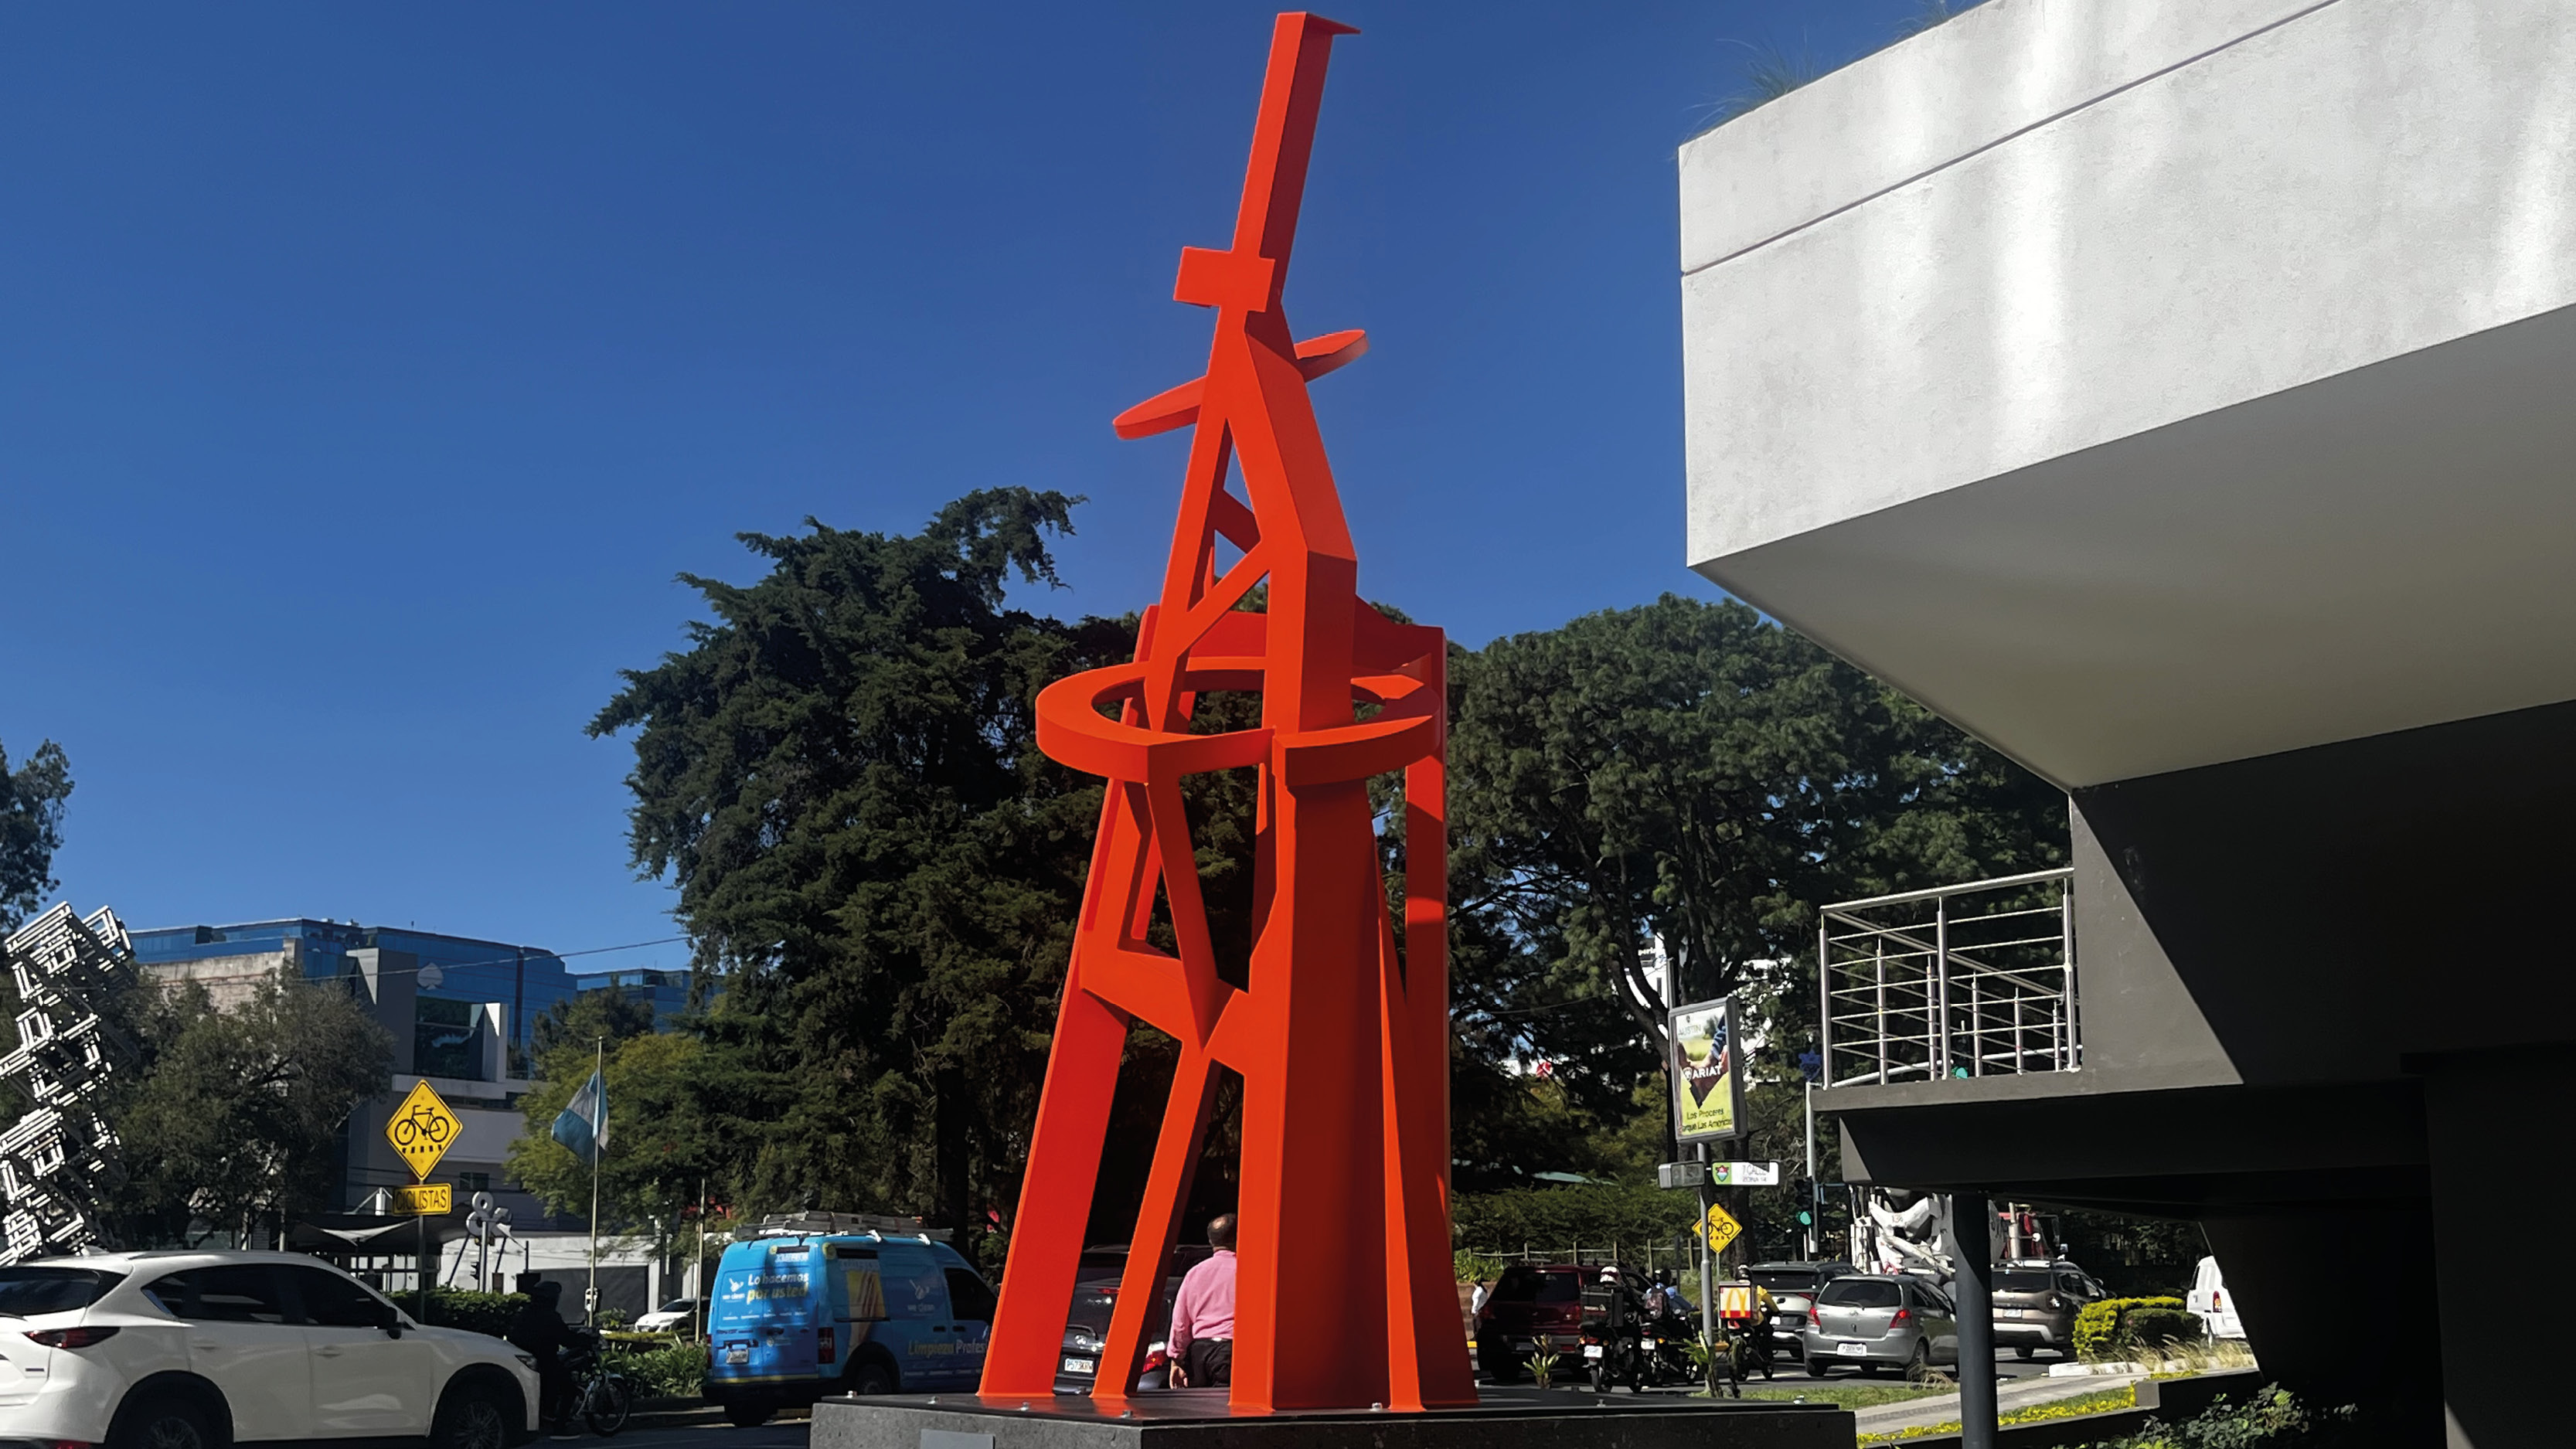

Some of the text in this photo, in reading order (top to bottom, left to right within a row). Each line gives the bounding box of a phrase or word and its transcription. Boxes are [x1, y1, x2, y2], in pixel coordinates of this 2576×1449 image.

[1693, 1064, 1722, 1080] ARIAT
[396, 1189, 447, 1212] CICLISTAS
[747, 1272, 809, 1286] Lo hacemos
[773, 1281, 809, 1298] usted
[907, 1338, 985, 1357] Limpieza Profes
